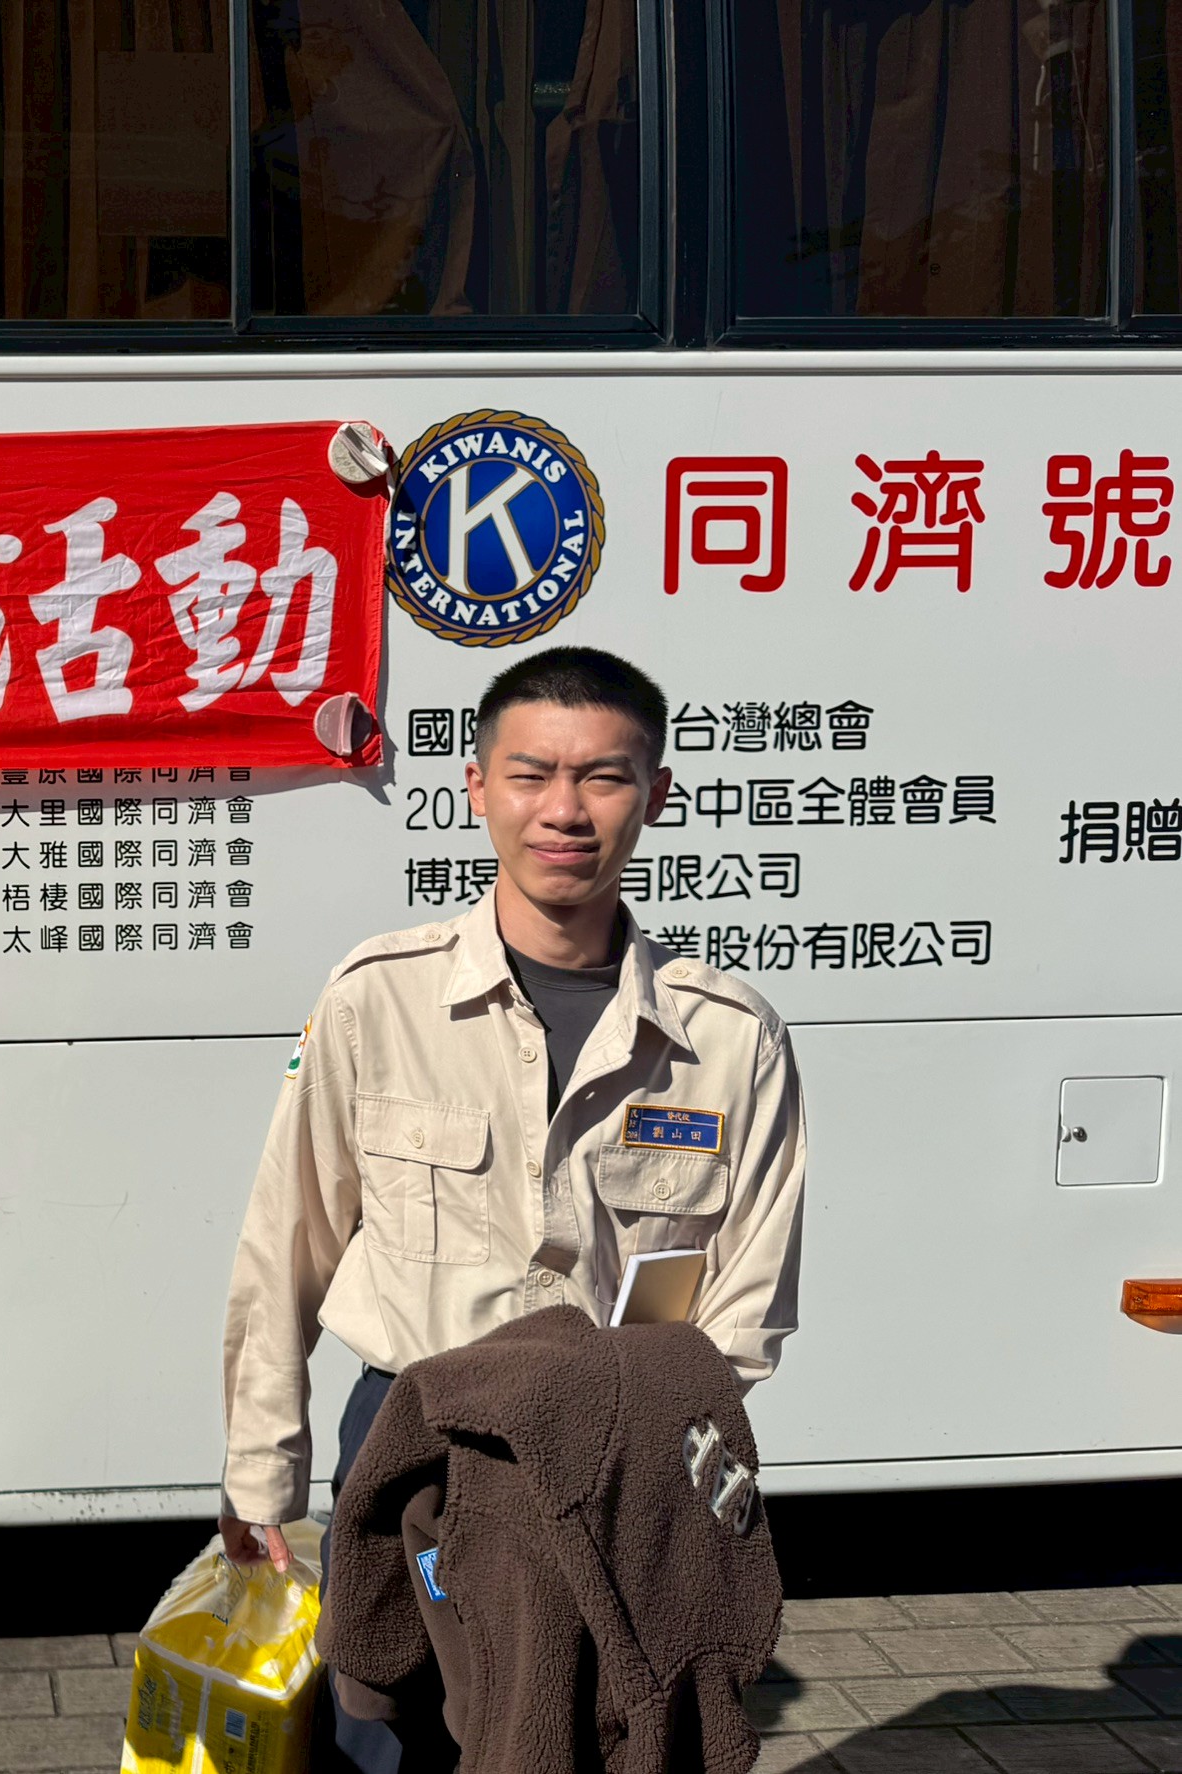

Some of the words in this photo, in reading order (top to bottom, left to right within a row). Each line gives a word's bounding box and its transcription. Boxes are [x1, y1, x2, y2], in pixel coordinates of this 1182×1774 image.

[418, 431, 567, 483] KIWANIS
[444, 463, 537, 595] K
[665, 449, 1174, 595] 同濟號
[395, 509, 585, 626] INTERNATIONAL
[1, 795, 254, 827] 大里國際同濟會
[1059, 797, 1182, 864] 捐贈
[2, 837, 254, 869] 大雅國際同濟會
[2, 880, 254, 911] 梧棲國際同濟會
[3, 921, 254, 953] 太峰國際同濟會
[641, 921, 992, 971] 業股份有限公司
